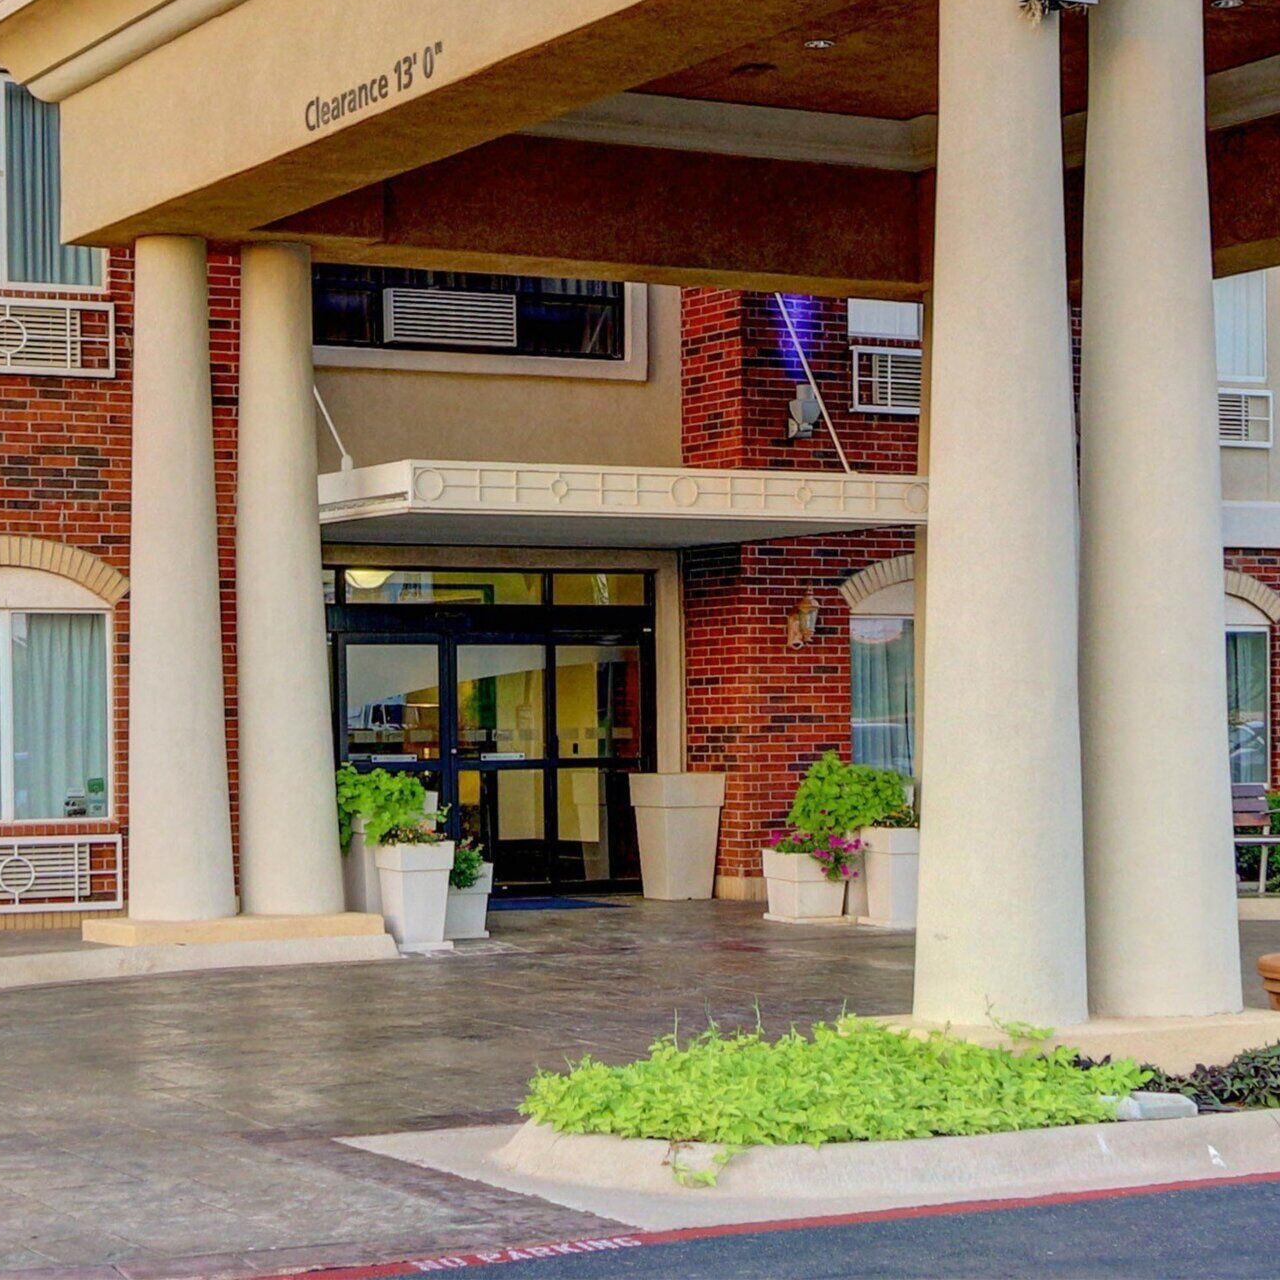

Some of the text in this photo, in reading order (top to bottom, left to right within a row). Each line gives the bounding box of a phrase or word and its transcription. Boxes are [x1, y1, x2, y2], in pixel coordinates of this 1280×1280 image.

[305, 74, 389, 132] Clearance
[394, 52, 418, 92] 13'
[411, 1236, 642, 1271] NO PARKING
